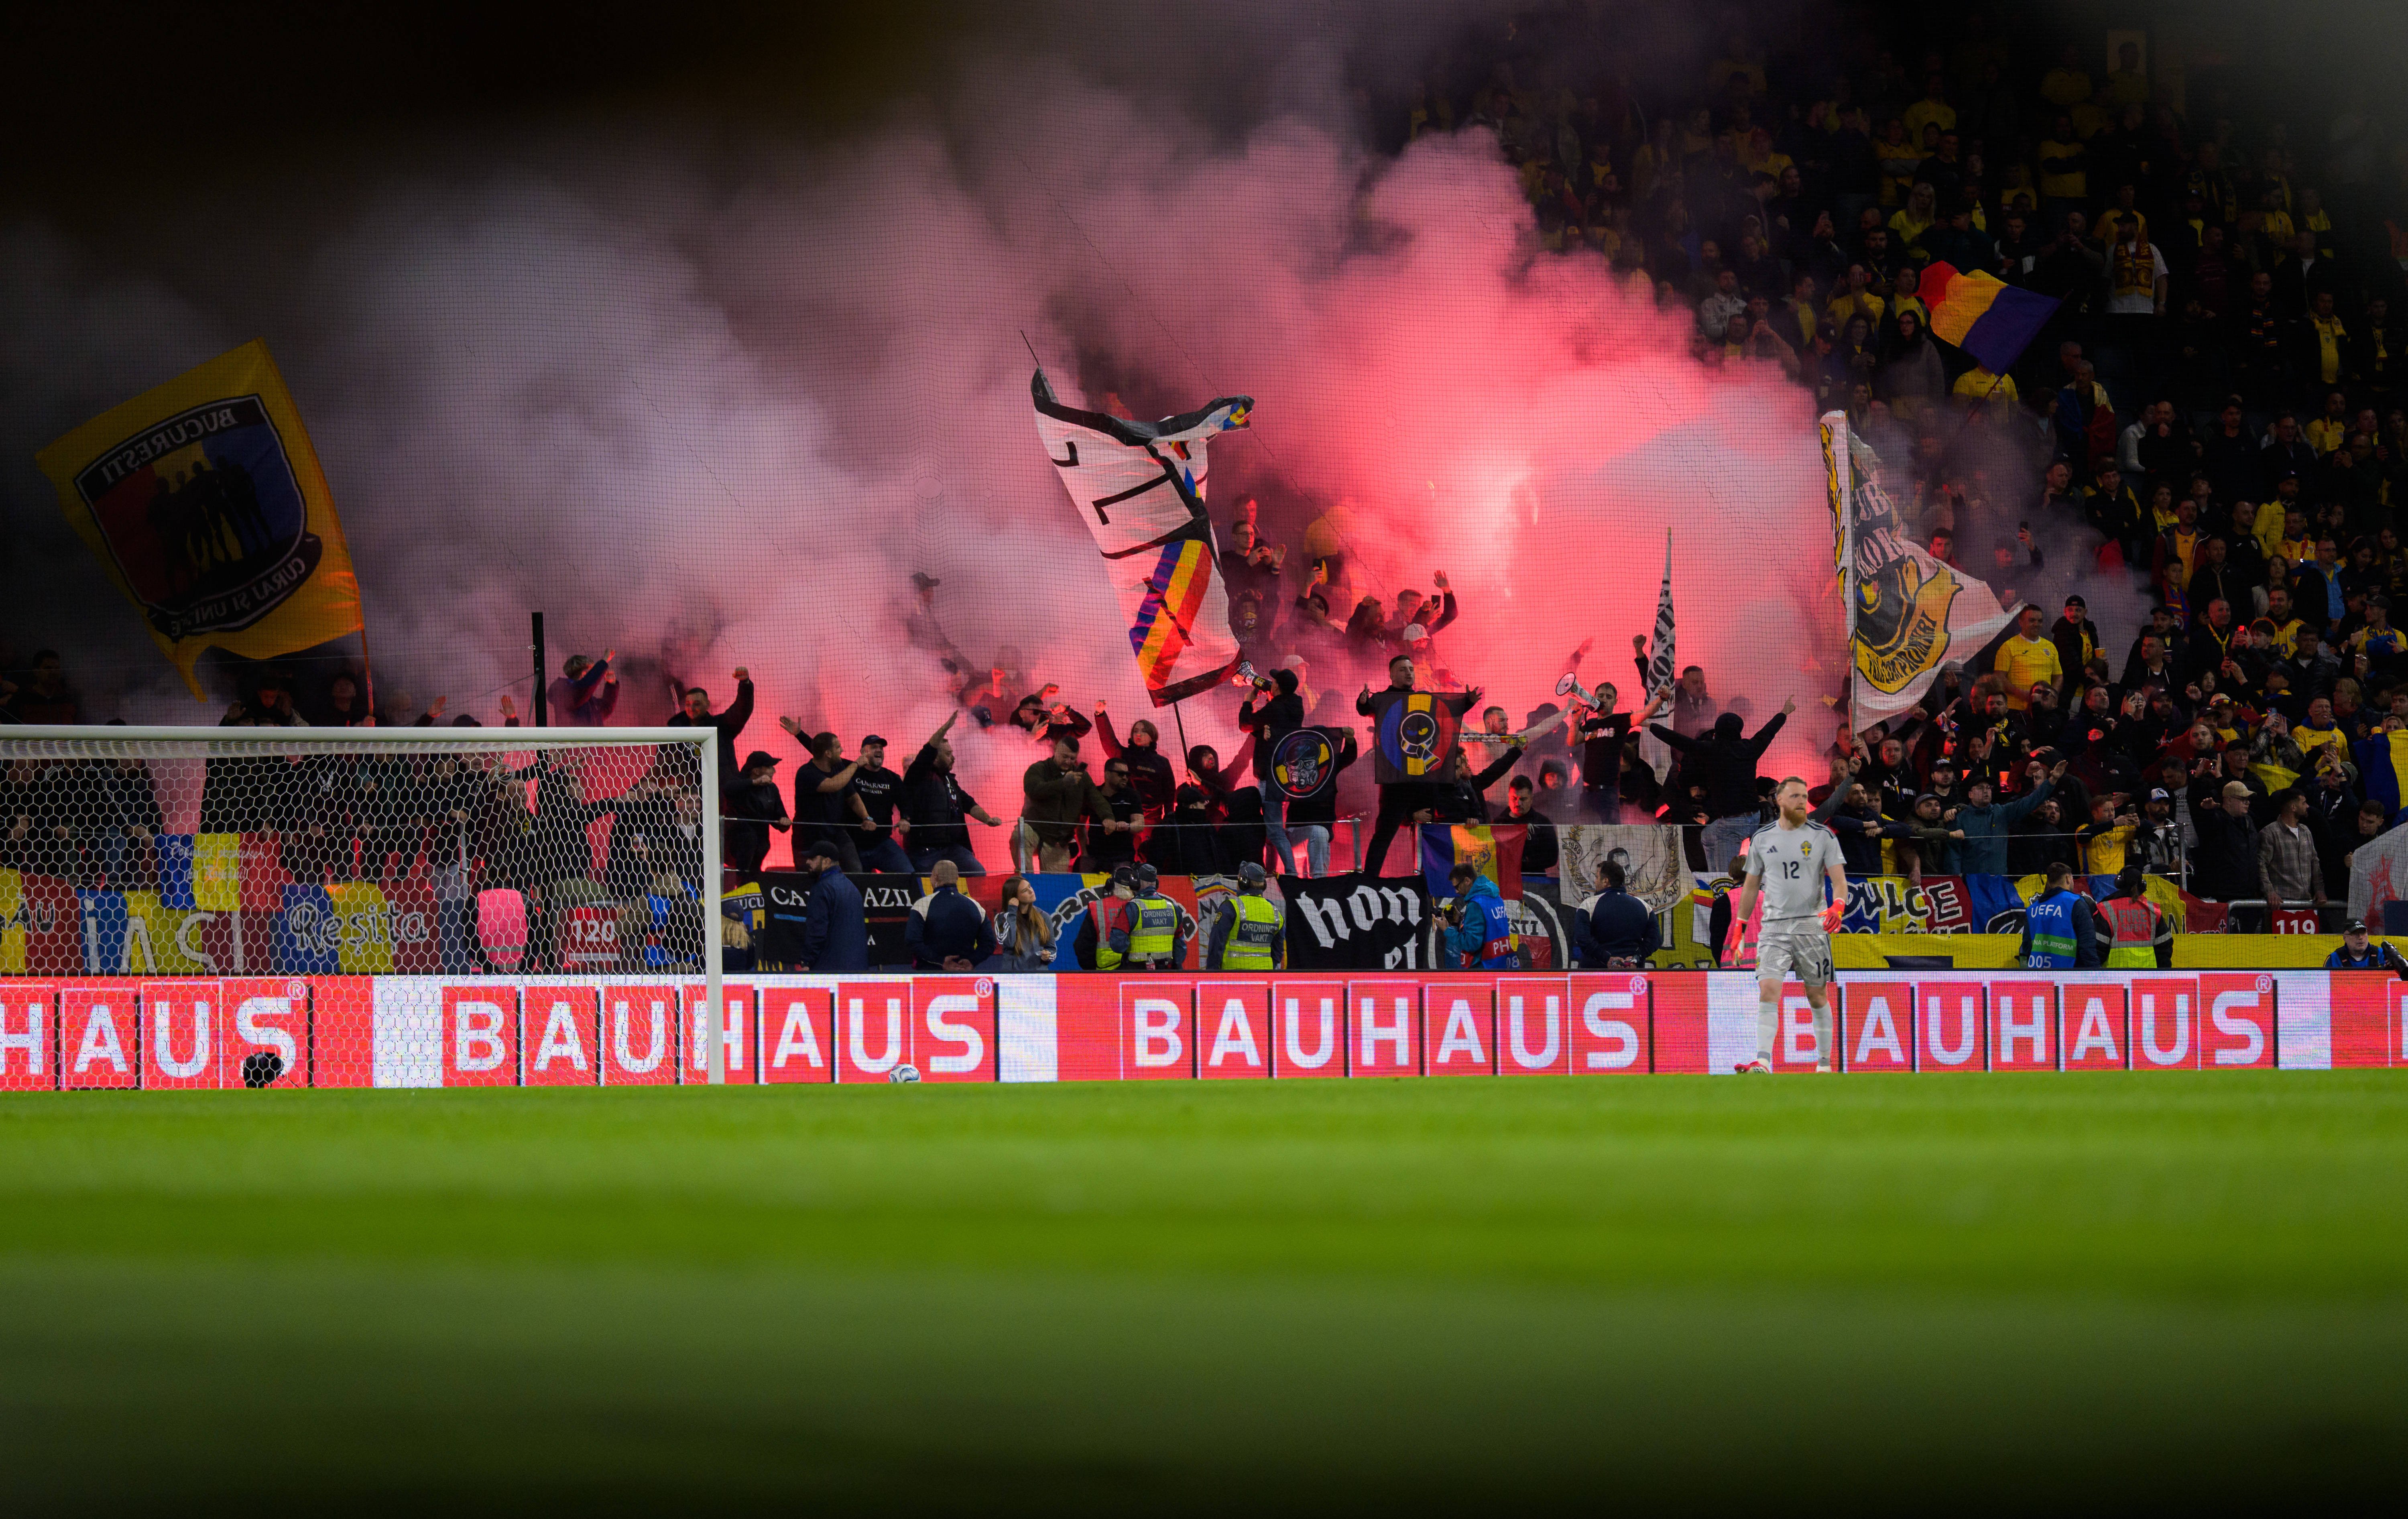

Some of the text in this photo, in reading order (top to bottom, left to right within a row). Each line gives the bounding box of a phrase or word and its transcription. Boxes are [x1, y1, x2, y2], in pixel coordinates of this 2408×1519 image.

[1783, 861, 1800, 879] 12
[1143, 910, 1173, 919] ORDNINGS
[2031, 904, 2062, 918] UEFA
[2119, 909, 2147, 924] FIRE
[571, 919, 616, 943] 120
[2120, 923, 2148, 933] SAFETY
[2276, 919, 2316, 934] 119
[1251, 933, 1269, 942] VAKT
[2046, 940, 2074, 951] PLATFORM
[1816, 958, 1830, 978] 12
[2028, 954, 2052, 968] 005
[458, 994, 984, 1073] BAUHAUS
[1134, 992, 1638, 1069] BAUHAUS
[1784, 990, 2264, 1065] BAUHAUS
